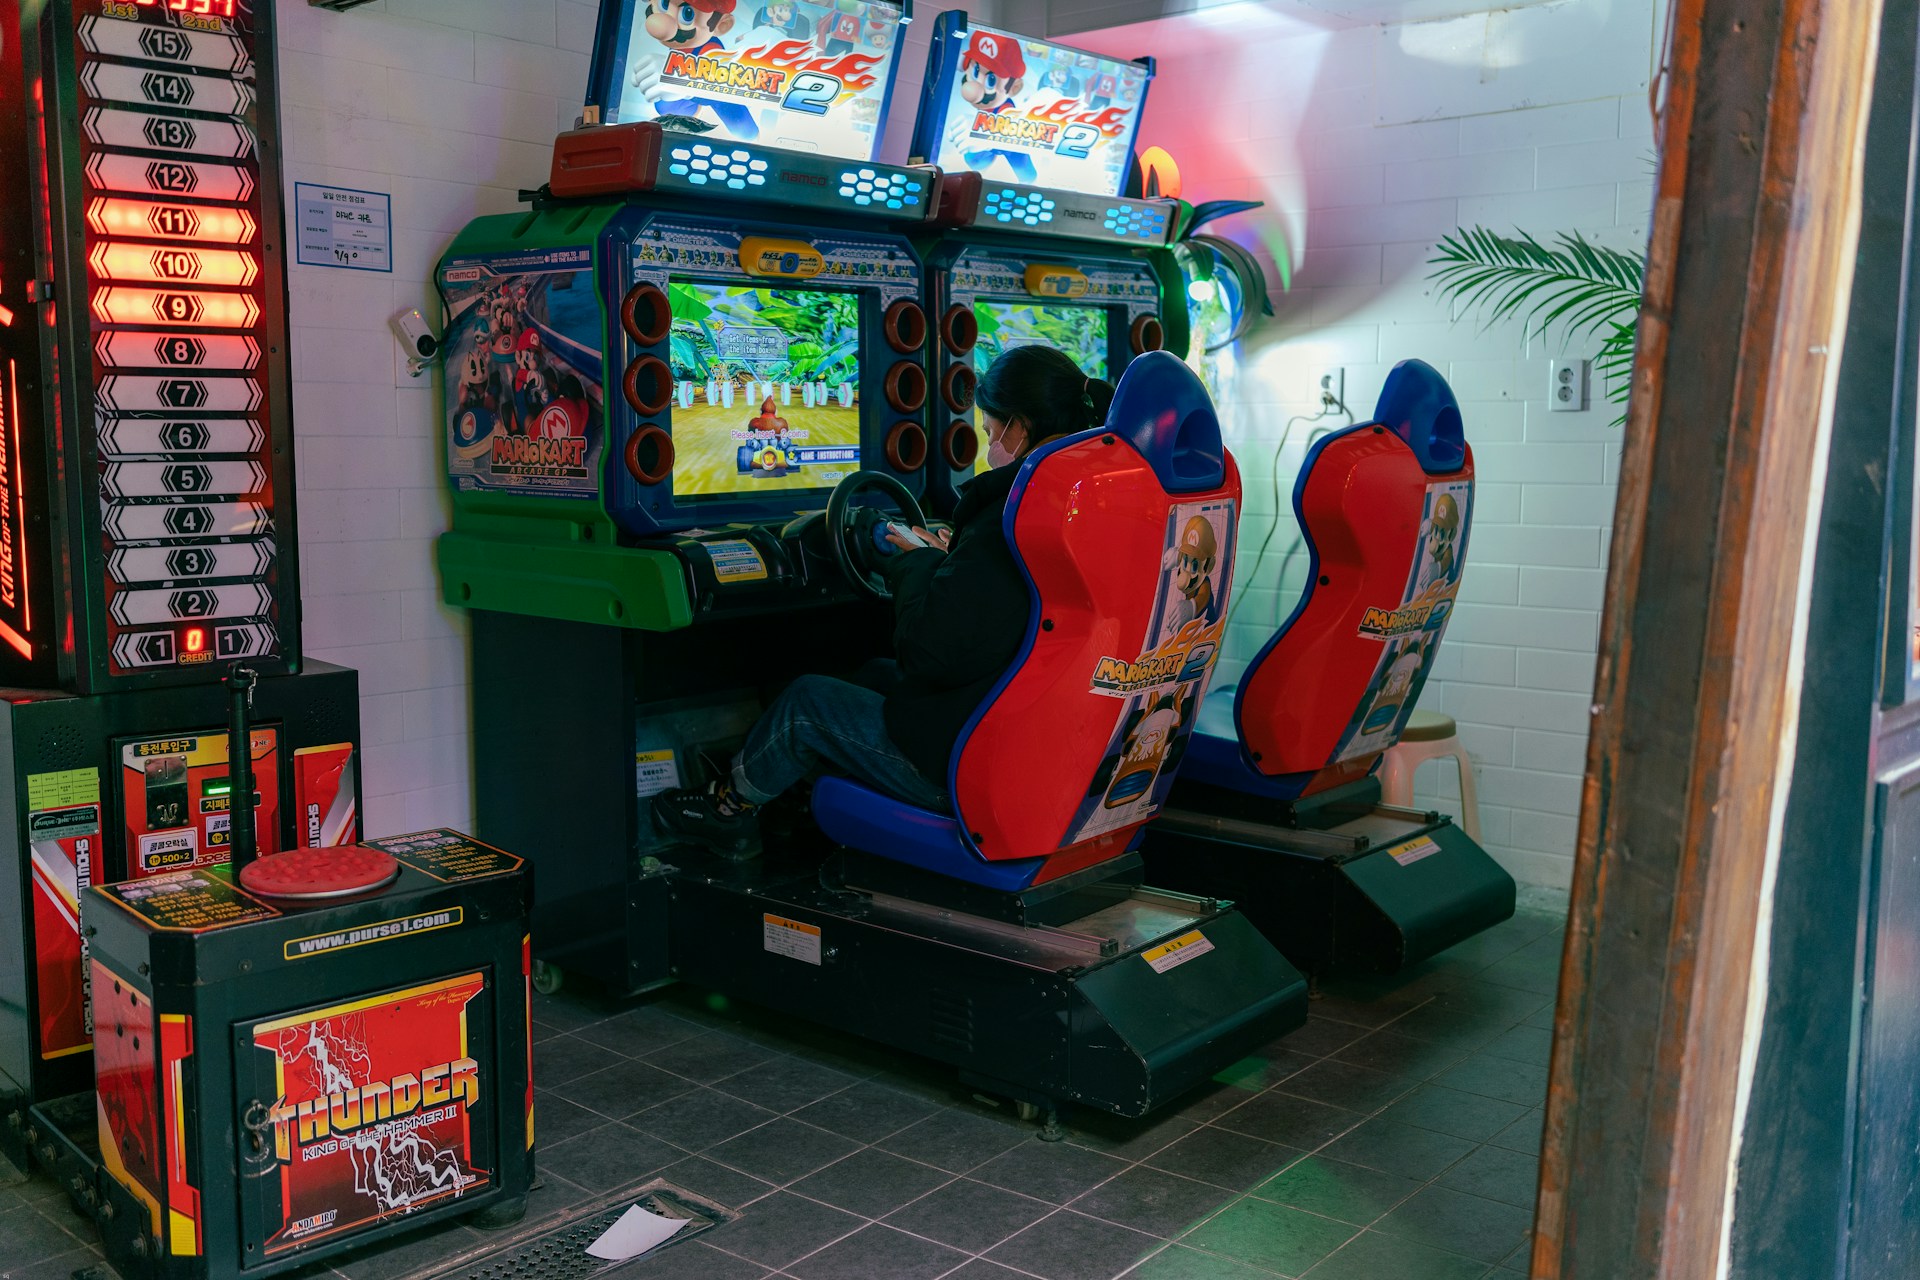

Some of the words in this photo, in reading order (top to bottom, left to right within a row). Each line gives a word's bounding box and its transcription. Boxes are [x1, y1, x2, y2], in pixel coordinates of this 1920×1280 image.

[102, 1, 139, 20] 1st
[182, 13, 222, 31] 2nd
[153, 32, 178, 55] 15
[155, 77, 180, 100] 14
[687, 81, 737, 96] ARCADE
[744, 91, 760, 99] GP
[782, 71, 841, 116] 2
[157, 121, 182, 144] 13
[987, 136, 1024, 146] ARCADE
[1055, 123, 1100, 159] 2
[159, 167, 185, 188] 12
[781, 170, 826, 187] namco
[322, 192, 334, 200] 일일
[335, 194, 347, 202] 안전
[349, 196, 365, 204] 점검표
[161, 210, 185, 232] 11
[1063, 209, 1096, 220] namco
[163, 254, 189, 275] 10
[449, 270, 477, 279] namco
[172, 297, 187, 319] 9
[729, 334, 739, 343] Get
[743, 334, 758, 344] items
[762, 336, 775, 344] from
[729, 345, 739, 353] the
[743, 345, 756, 353] item
[174, 341, 188, 361] 8
[176, 385, 191, 404] 7
[179, 427, 192, 447] 6
[731, 429, 754, 440] Please
[781, 429, 787, 439] 2
[800, 451, 814, 460] GAME
[817, 450, 854, 460] INSTRUCTIONS
[181, 470, 195, 489] 5
[0, 487, 10, 518] THE
[182, 512, 196, 530] 4
[2, 519, 12, 545] OF
[185, 553, 198, 572] 3
[0, 541, 14, 608] KING
[188, 594, 201, 613] 2
[1422, 600, 1453, 632] 2
[155, 638, 166, 657] 1
[186, 629, 203, 651] 0
[223, 633, 233, 651] 1
[179, 651, 214, 664] CREDIT
[1176, 641, 1216, 684] 2
[139, 741, 191, 755] 동전투입구
[308, 804, 320, 839] SHOW
[76, 839, 90, 877] SHOW
[299, 912, 450, 953] www.purse1.com
[269, 1057, 479, 1161] THUNDER
[303, 1141, 337, 1161] KING
[340, 1136, 355, 1149] OF
[358, 1130, 380, 1144] THE
[384, 1110, 443, 1135] HAMMER
[444, 1105, 457, 1120] II
[292, 1210, 336, 1233] ANDAMIRO
